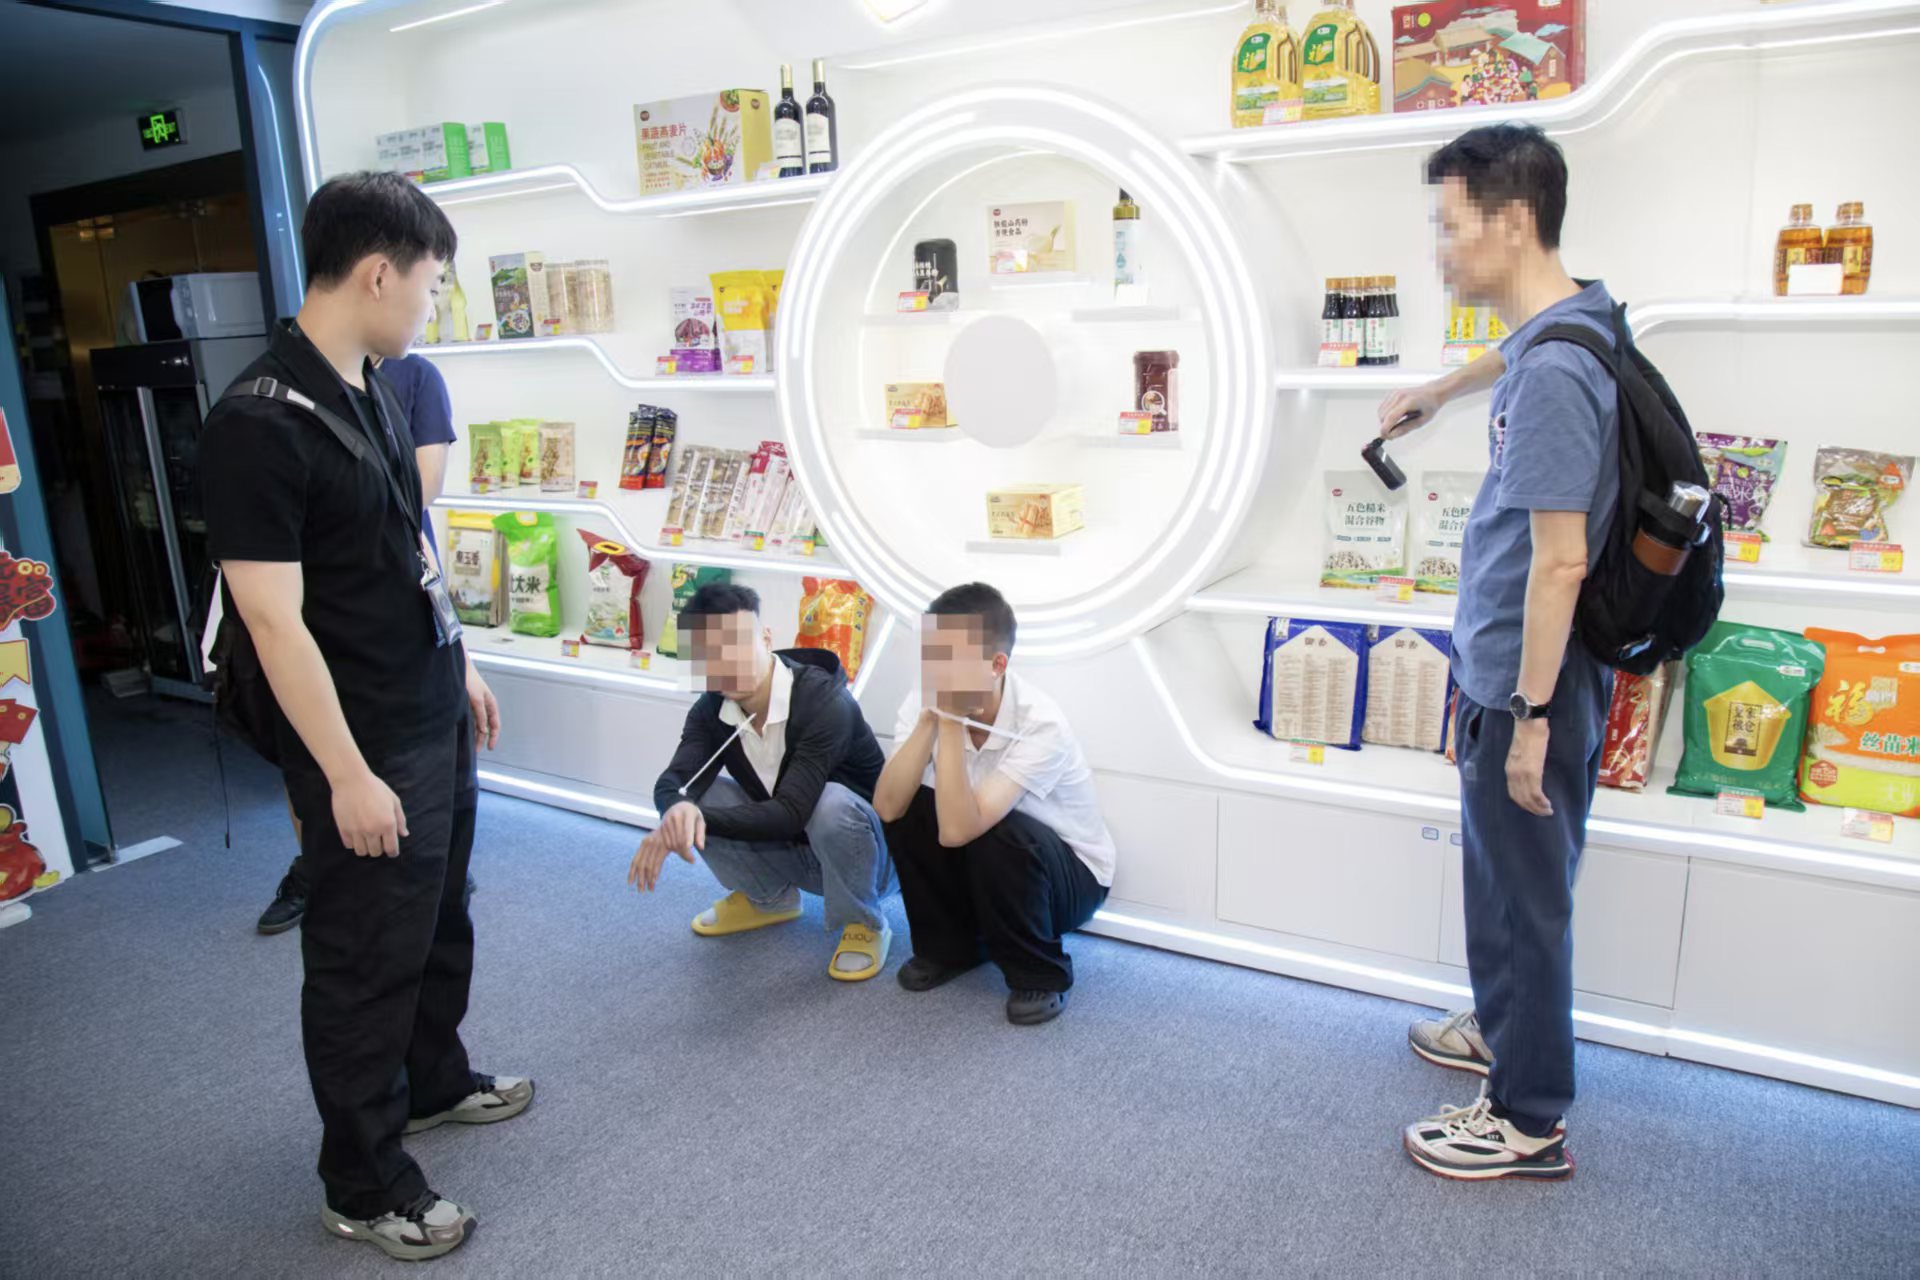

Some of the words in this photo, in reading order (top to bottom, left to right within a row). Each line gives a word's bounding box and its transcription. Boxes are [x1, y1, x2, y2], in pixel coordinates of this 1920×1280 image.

[1346, 502, 1386, 514] 五色糙米
[1344, 514, 1385, 527] 混合谷物
[511, 575, 541, 594] 大米
